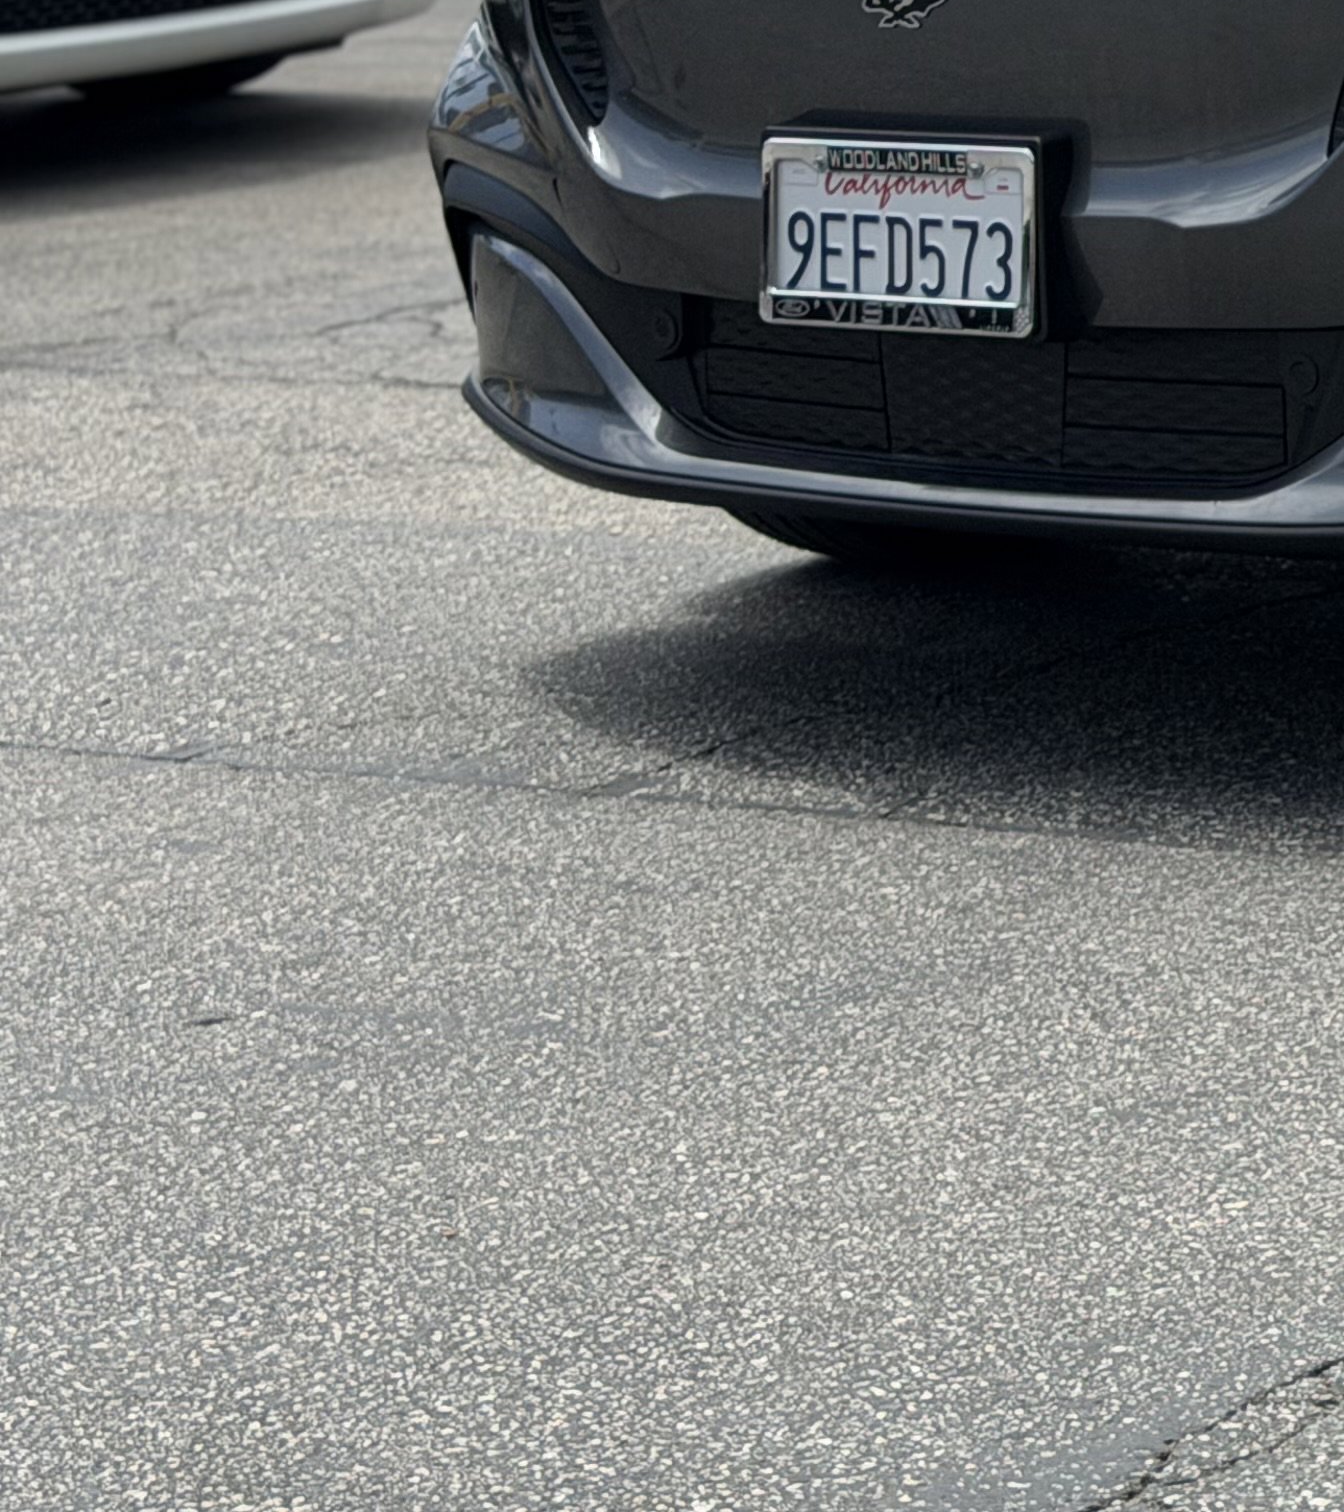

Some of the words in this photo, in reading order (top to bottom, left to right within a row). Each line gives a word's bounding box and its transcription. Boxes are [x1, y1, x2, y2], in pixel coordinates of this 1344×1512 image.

[829, 149, 920, 172] WOODLAND
[921, 153, 967, 173] HILLS
[825, 172, 985, 209] California
[786, 210, 1013, 301] 9EFD573
[826, 300, 931, 329] VISTA
